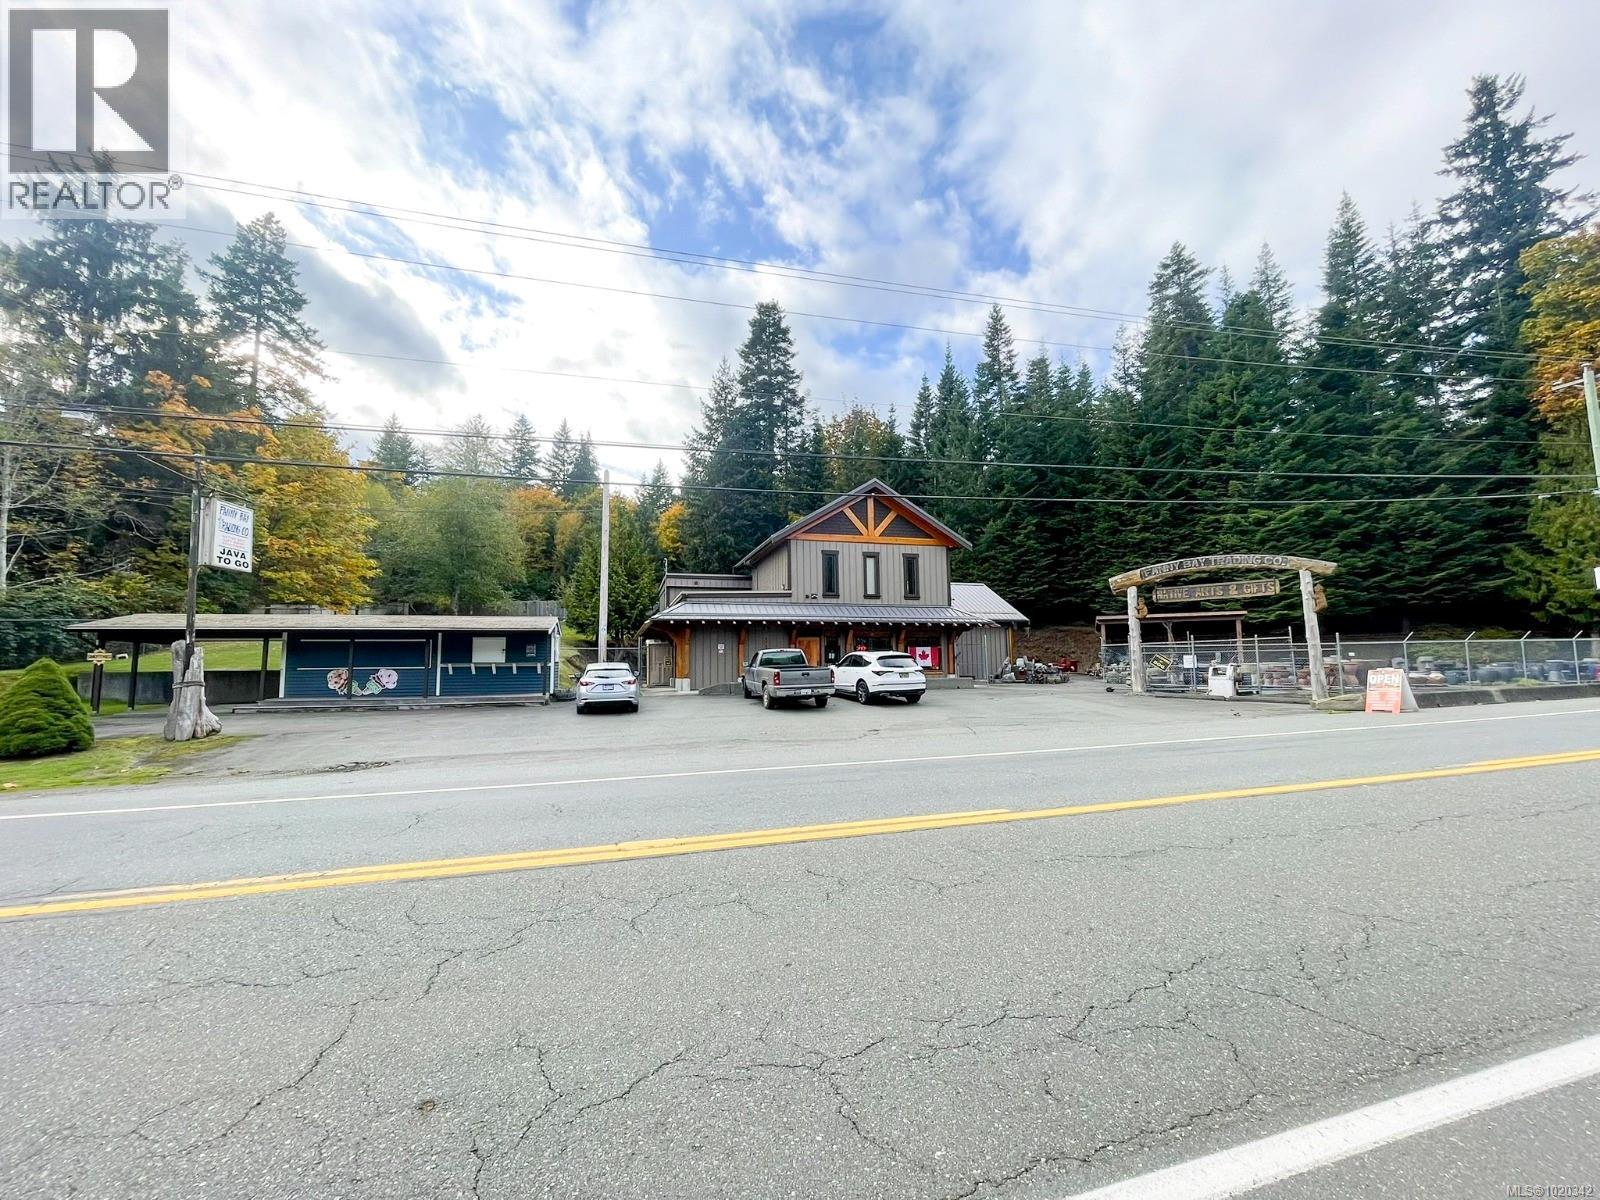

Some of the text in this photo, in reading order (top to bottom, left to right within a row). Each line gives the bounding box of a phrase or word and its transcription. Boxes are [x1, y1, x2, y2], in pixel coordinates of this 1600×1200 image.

[220, 548, 247, 560] JAVA
[216, 555, 250, 569] TO GO
[1143, 562, 1180, 577] FANNY
[1183, 558, 1206, 569] BAY
[1210, 555, 1262, 565] TRADING
[1156, 588, 1190, 600] NATIVE
[1195, 586, 1224, 599] ARTS
[1243, 581, 1275, 594] GIFTS
[1369, 673, 1401, 684] OPEN
